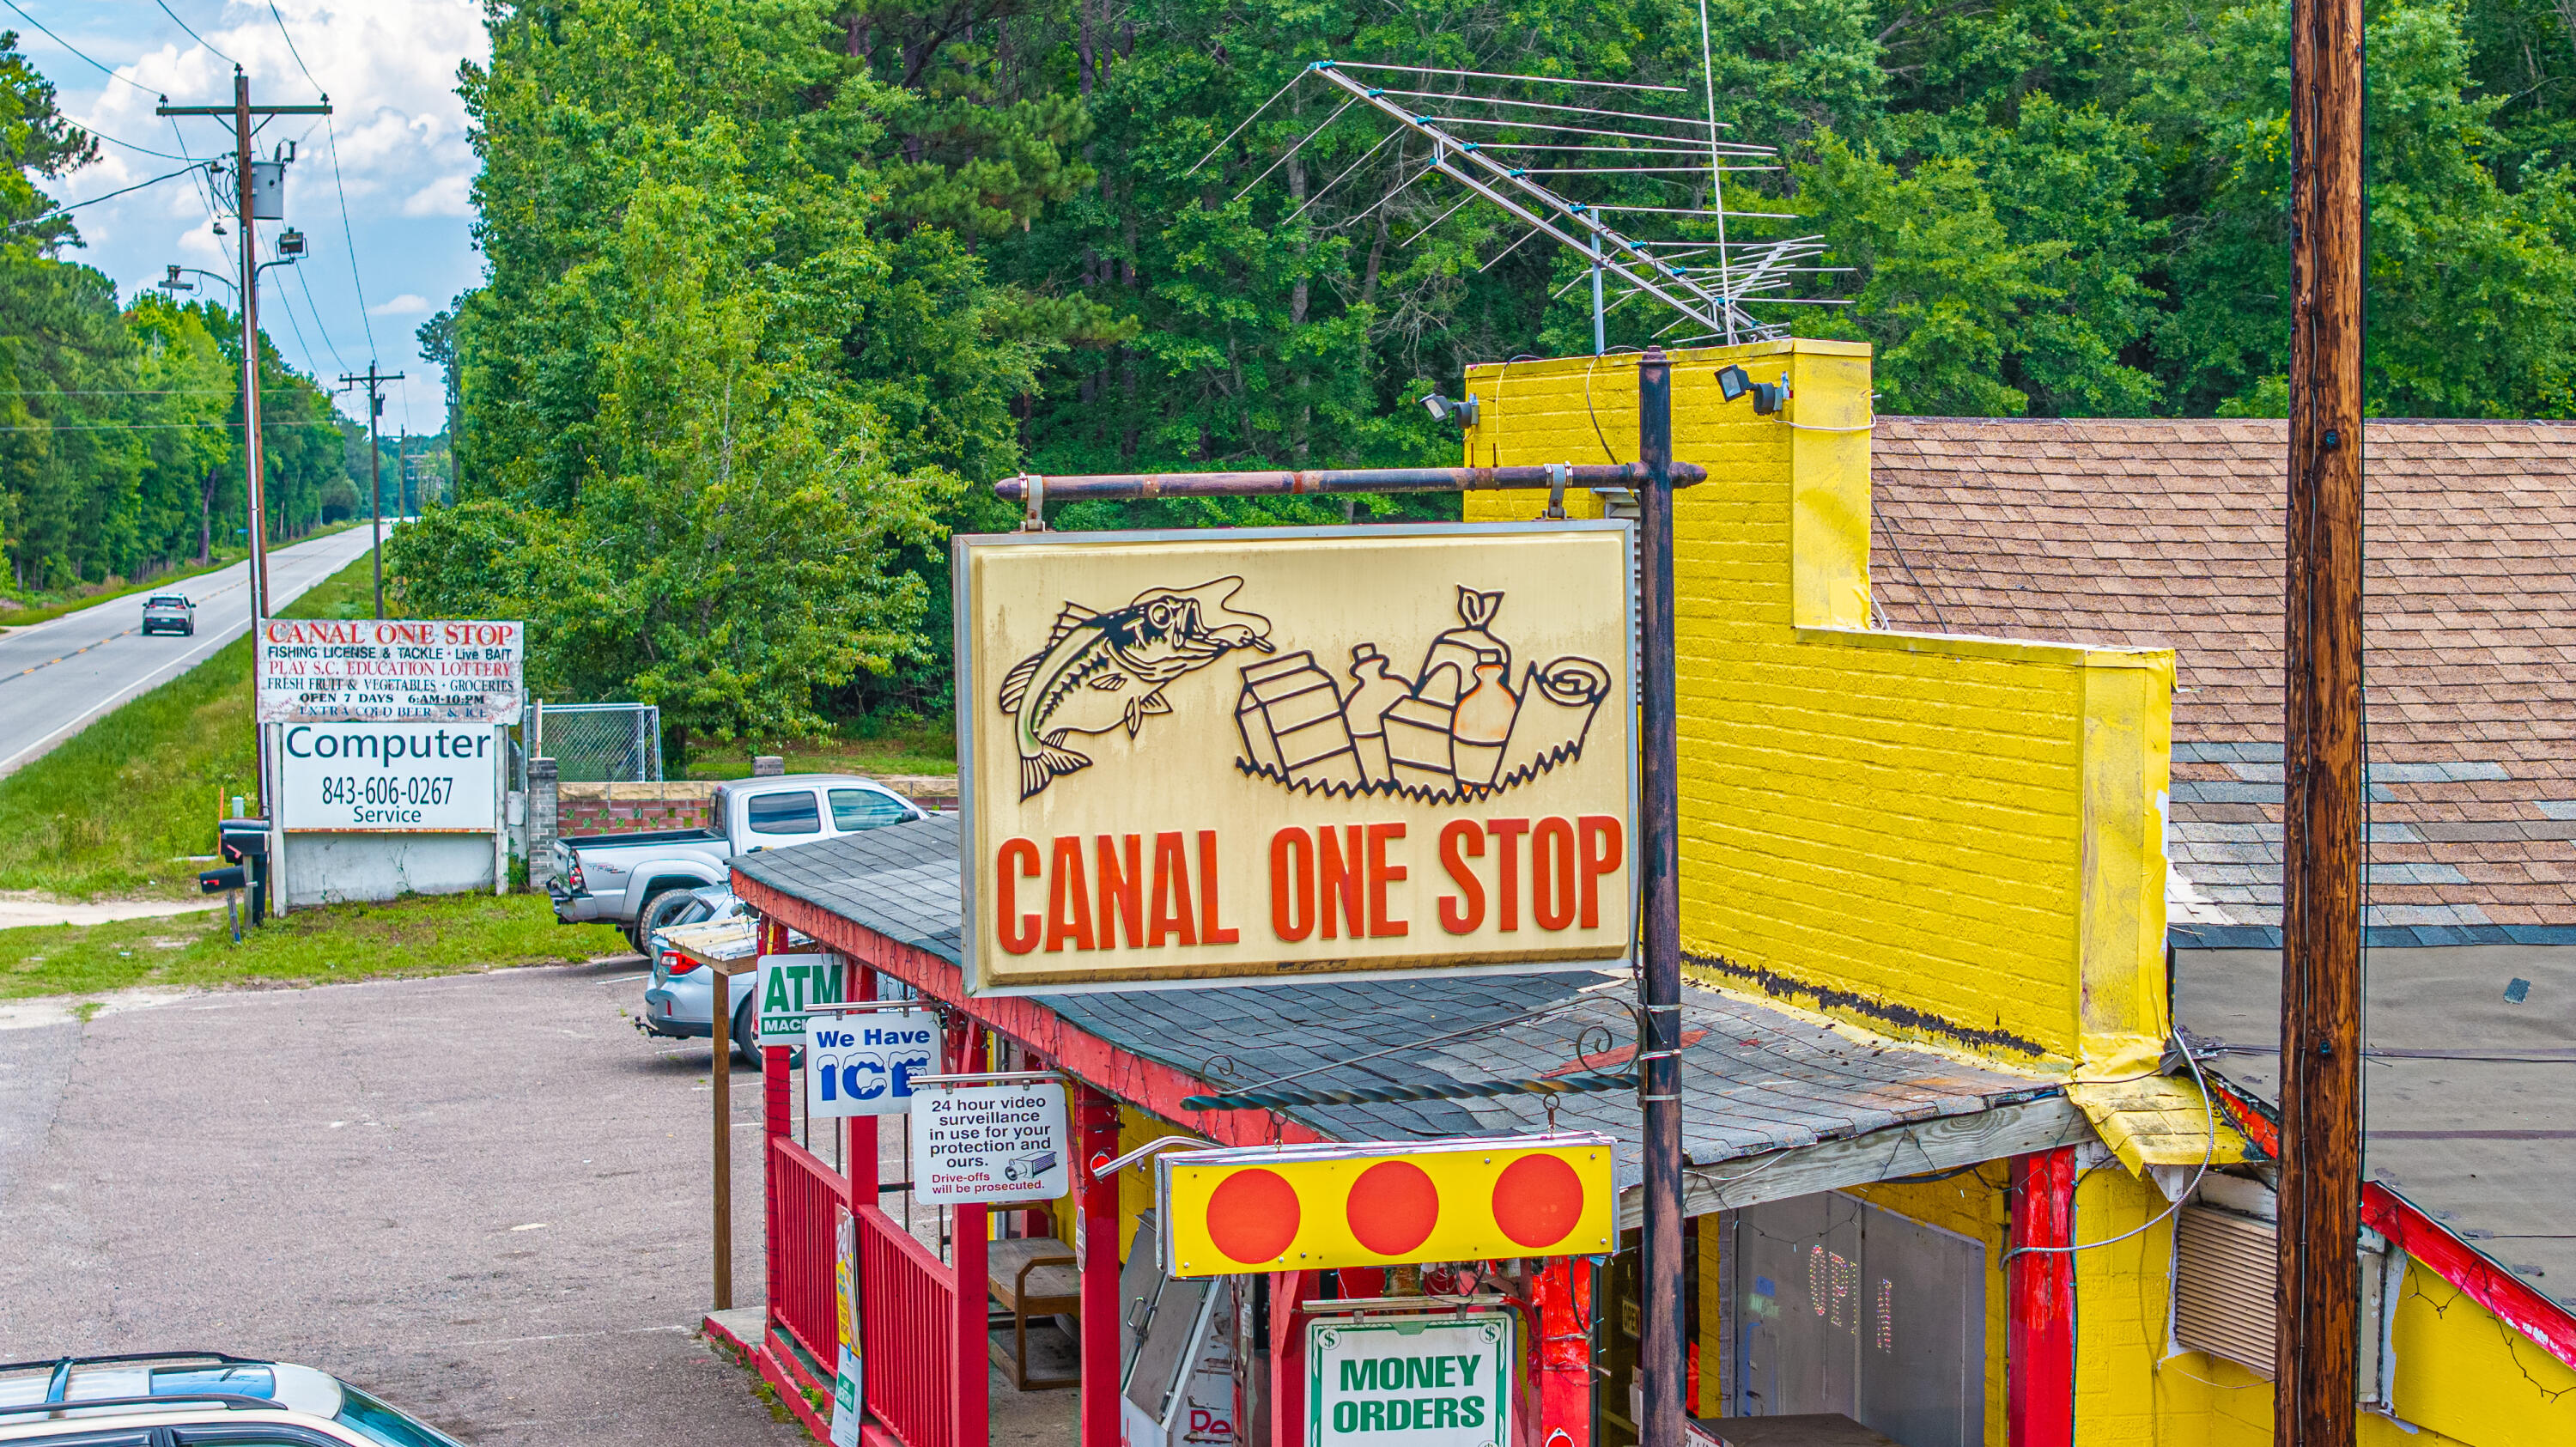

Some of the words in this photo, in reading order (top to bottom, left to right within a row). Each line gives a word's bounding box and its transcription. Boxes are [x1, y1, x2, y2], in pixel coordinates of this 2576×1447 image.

[266, 623, 366, 644] CANAL
[374, 623, 435, 646] ONE
[444, 623, 513, 647] STOP
[268, 646, 318, 659] FISHING
[323, 647, 376, 659] LICENSE
[382, 648, 391, 659] &
[398, 648, 443, 660] TACKLE
[455, 648, 479, 660] Live
[485, 648, 513, 660] BAIT
[269, 660, 307, 675] PLAY
[313, 660, 339, 675] S.C.
[347, 661, 434, 676] EDUCATION
[440, 661, 512, 677] LOTTERY
[268, 678, 304, 690] FRESH
[309, 678, 343, 690] FRUIT
[347, 678, 357, 690] &
[364, 679, 436, 692] VEGETABLES
[450, 679, 513, 692] GROCERIES
[343, 694, 351, 702] 7
[359, 694, 394, 703] DAYS
[300, 707, 349, 716] EXTRA
[398, 708, 431, 717] BEER
[287, 726, 491, 768] Computer
[322, 776, 453, 805] 843-606-0267
[353, 806, 422, 823] Service
[997, 830, 1240, 955] CANAL
[1270, 822, 1409, 942] ONE
[1438, 815, 1624, 935] STOP
[763, 964, 843, 1012] ATM
[816, 1031, 855, 1048] We
[864, 1028, 931, 1046] Have
[817, 1049, 931, 1101] ICE
[932, 1100, 951, 1112] 24
[957, 1098, 996, 1110] hour
[1000, 1096, 1047, 1109] video
[939, 1111, 1041, 1126] surveillance
[929, 1128, 945, 1140] in
[951, 1128, 980, 1140] use
[985, 1126, 1008, 1138] for
[1013, 1125, 1051, 1140] your
[930, 1140, 1015, 1158] protection
[1020, 1137, 1051, 1151] and
[946, 1157, 988, 1168] ours.
[932, 1172, 991, 1183] Drive-offs
[932, 1184, 952, 1195] will
[956, 1183, 971, 1194] be
[975, 1180, 1045, 1195] prosecuted.
[1340, 1354, 1482, 1391] MONEY
[1333, 1395, 1485, 1433] ORDERS
